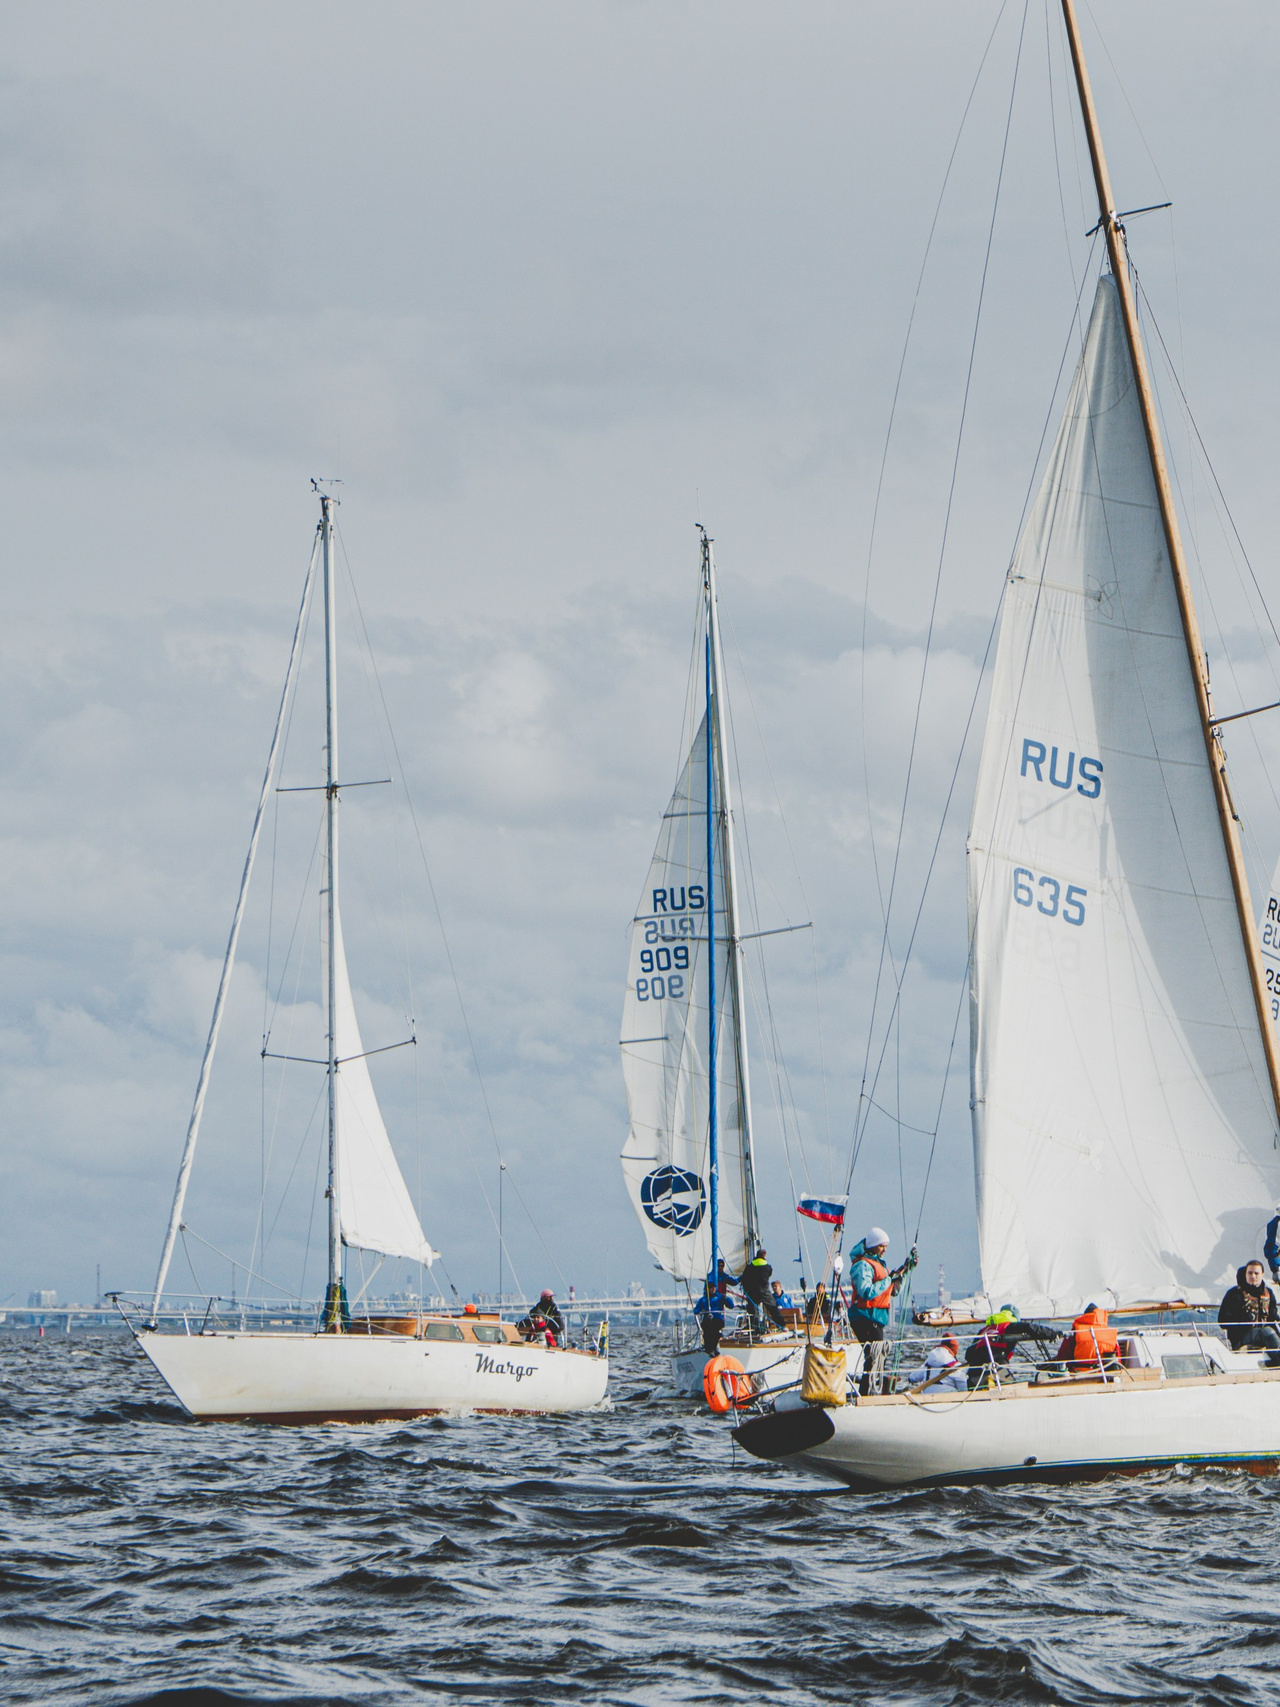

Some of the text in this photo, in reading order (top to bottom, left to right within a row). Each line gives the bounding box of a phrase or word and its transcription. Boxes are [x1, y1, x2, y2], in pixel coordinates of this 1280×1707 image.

[1020, 738, 1104, 799] RUS
[652, 885, 705, 913] RUS
[1013, 867, 1087, 927] 635
[640, 946, 690, 973] 909
[475, 1353, 538, 1382] Margo
